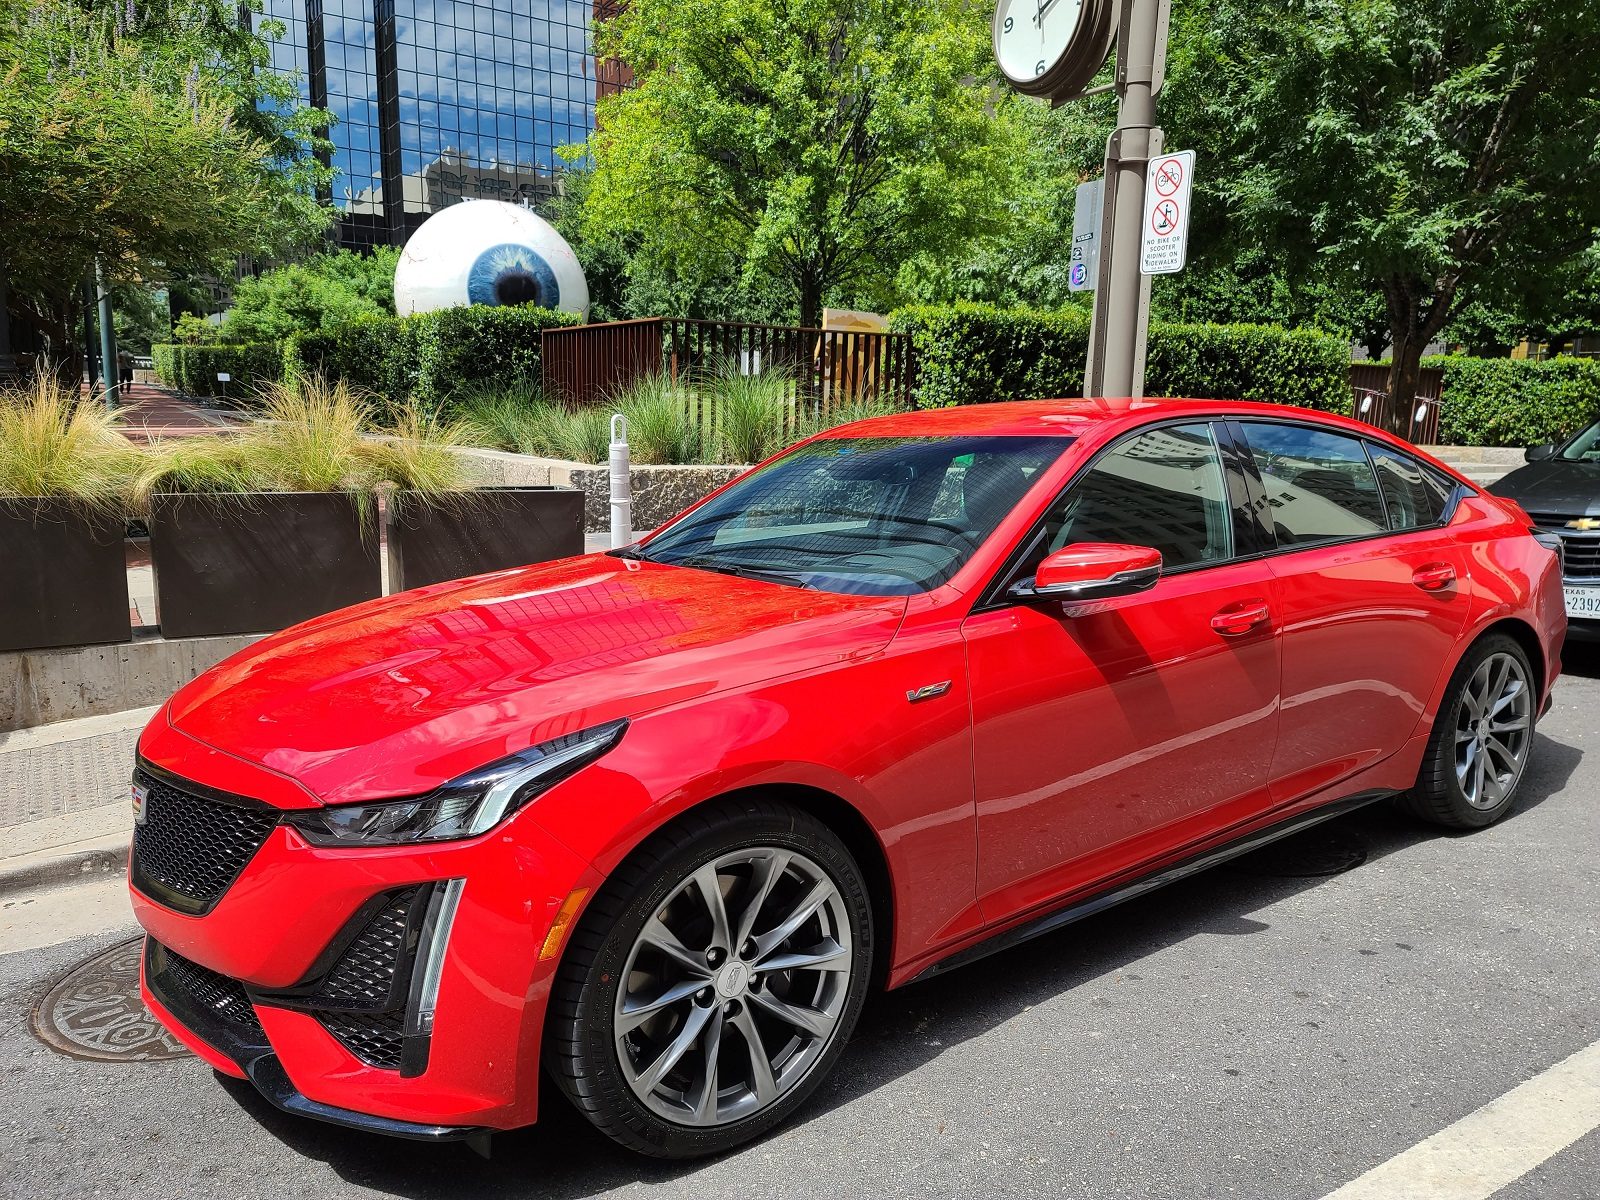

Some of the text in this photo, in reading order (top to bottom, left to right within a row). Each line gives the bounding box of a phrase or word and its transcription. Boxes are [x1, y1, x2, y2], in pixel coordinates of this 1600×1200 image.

[1004, 17, 1014, 34] 9
[1035, 60, 1046, 76] 6
[1150, 244, 1176, 252] SCOOTER
[1145, 258, 1178, 266] SIDEWALKS
